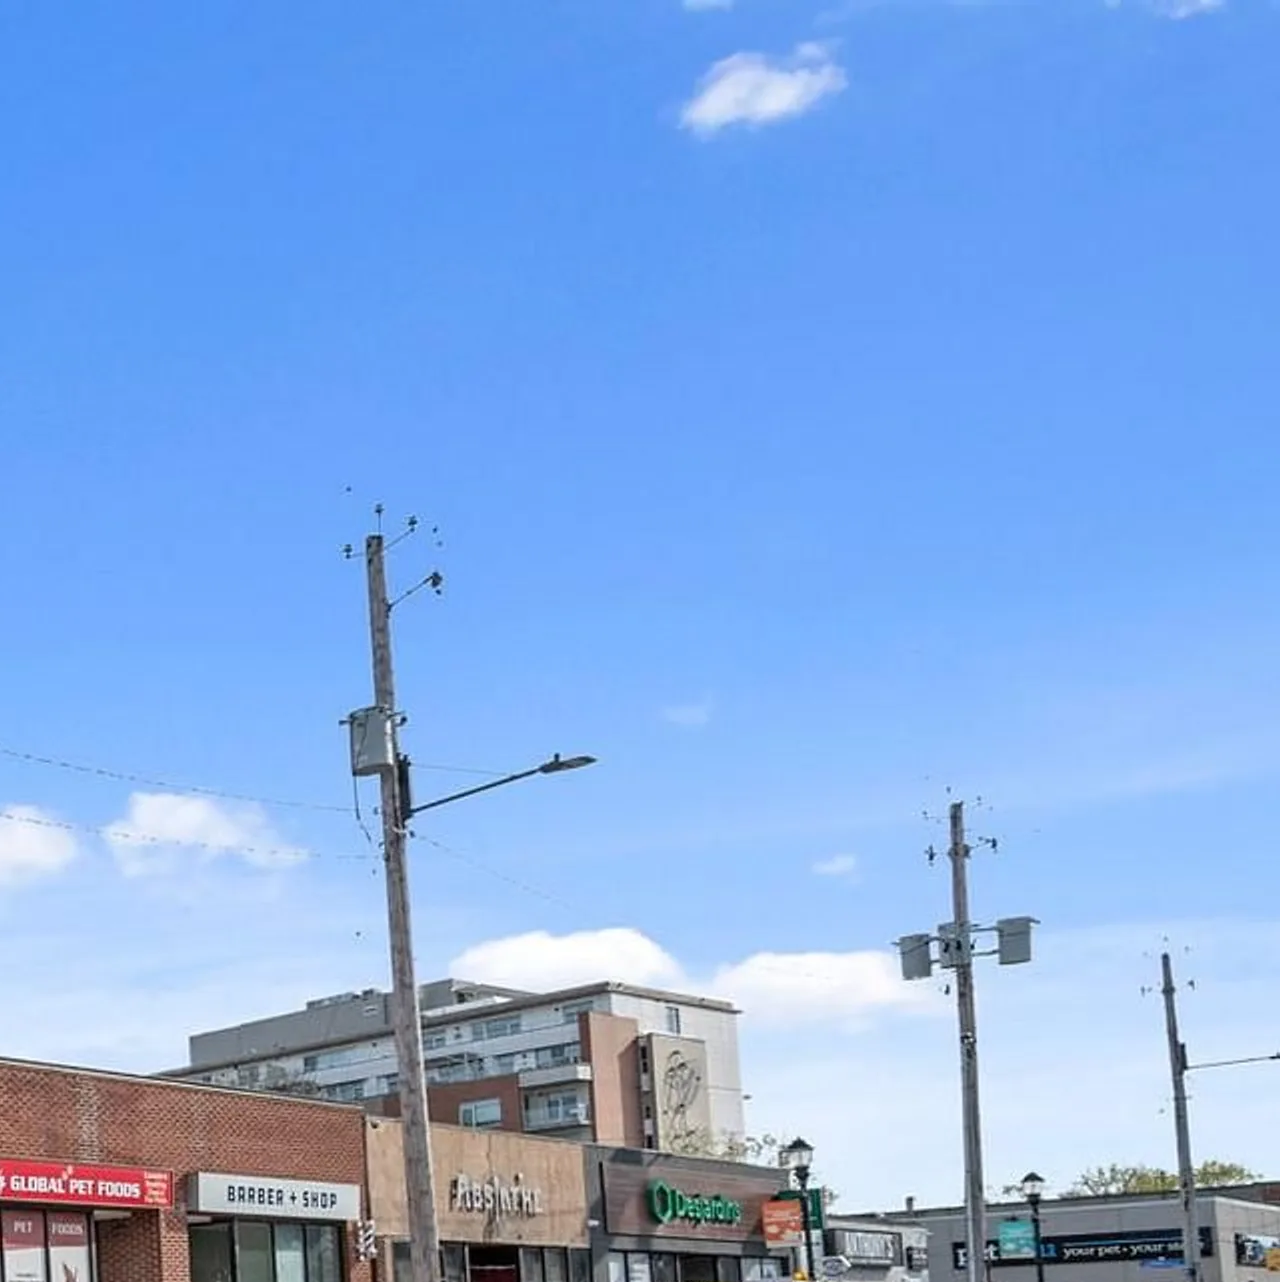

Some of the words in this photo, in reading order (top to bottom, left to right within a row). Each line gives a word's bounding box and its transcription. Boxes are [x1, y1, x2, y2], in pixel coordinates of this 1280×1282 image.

[9, 1174, 66, 1194] GLOBAL
[69, 1178, 94, 1195] PET
[97, 1180, 141, 1199] FOODS
[227, 1185, 284, 1206] BARBER
[302, 1190, 338, 1209] SHOP
[13, 1220, 33, 1234] PET
[51, 1221, 85, 1236] FOODS
